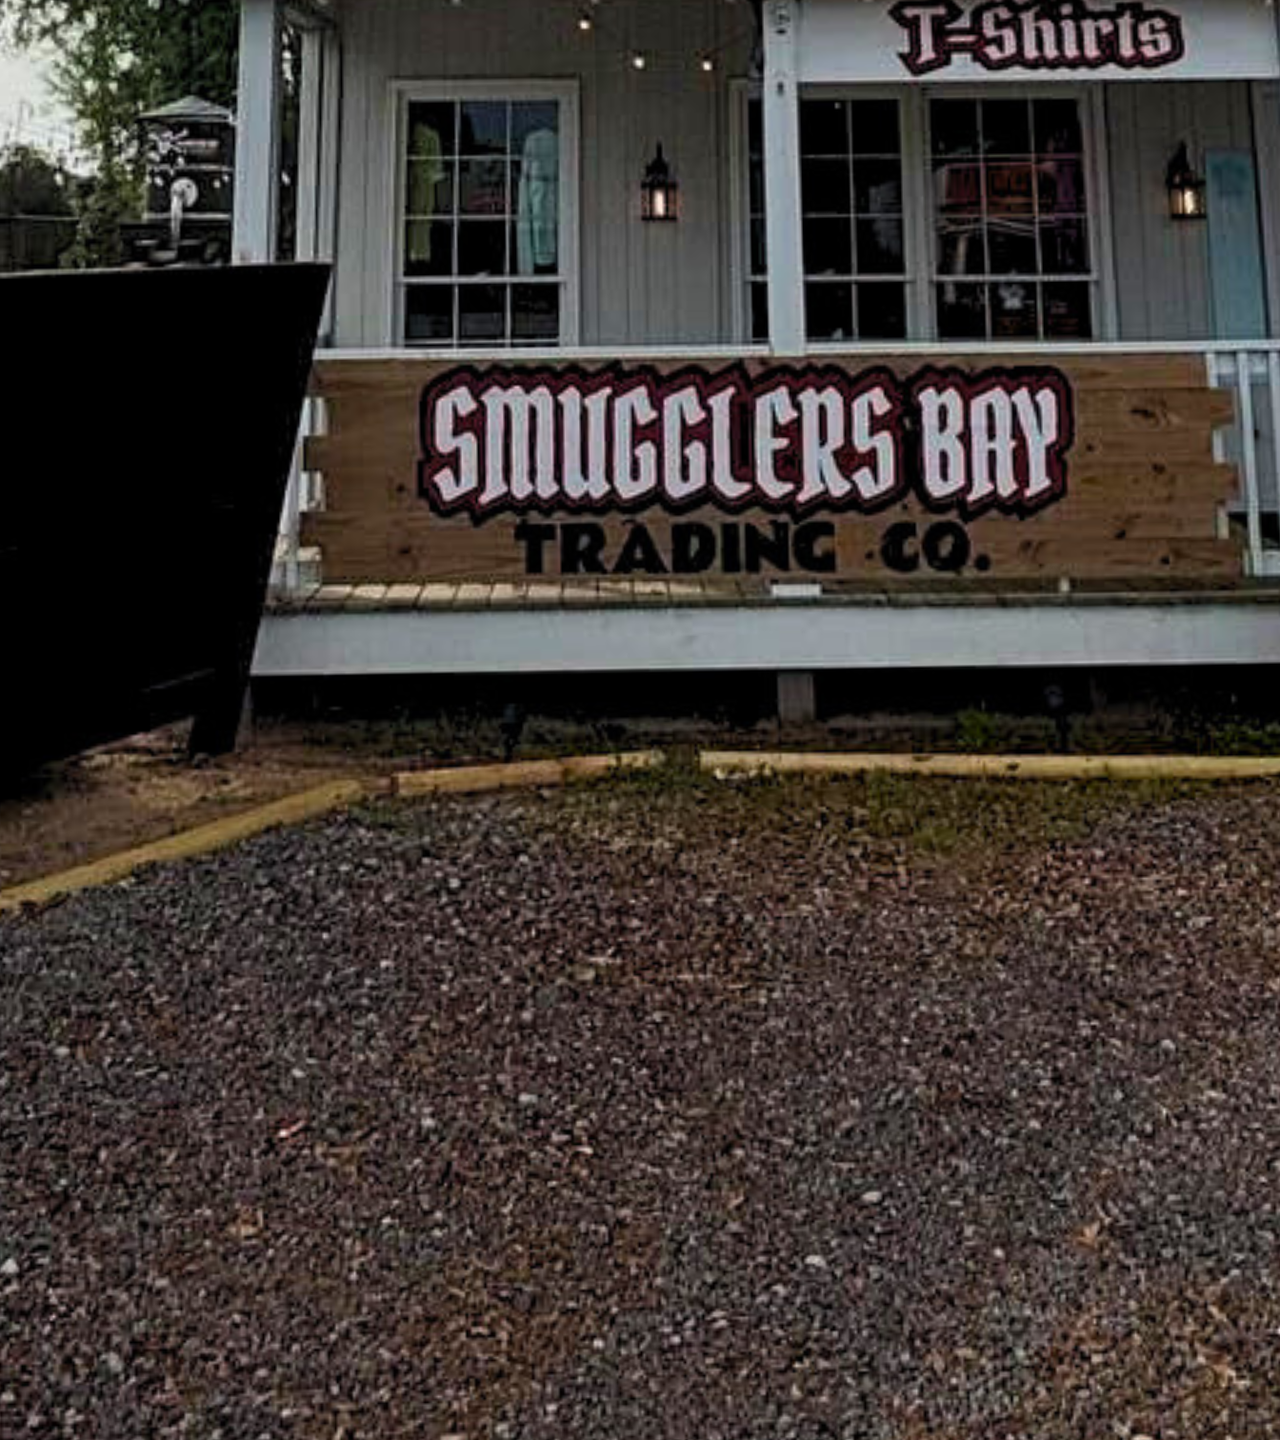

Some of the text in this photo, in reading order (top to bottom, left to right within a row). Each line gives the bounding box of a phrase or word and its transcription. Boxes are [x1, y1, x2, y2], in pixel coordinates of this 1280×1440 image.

[428, 382, 1060, 506] SMUGGLERS BAY
[514, 520, 992, 575] TRADING CO.
